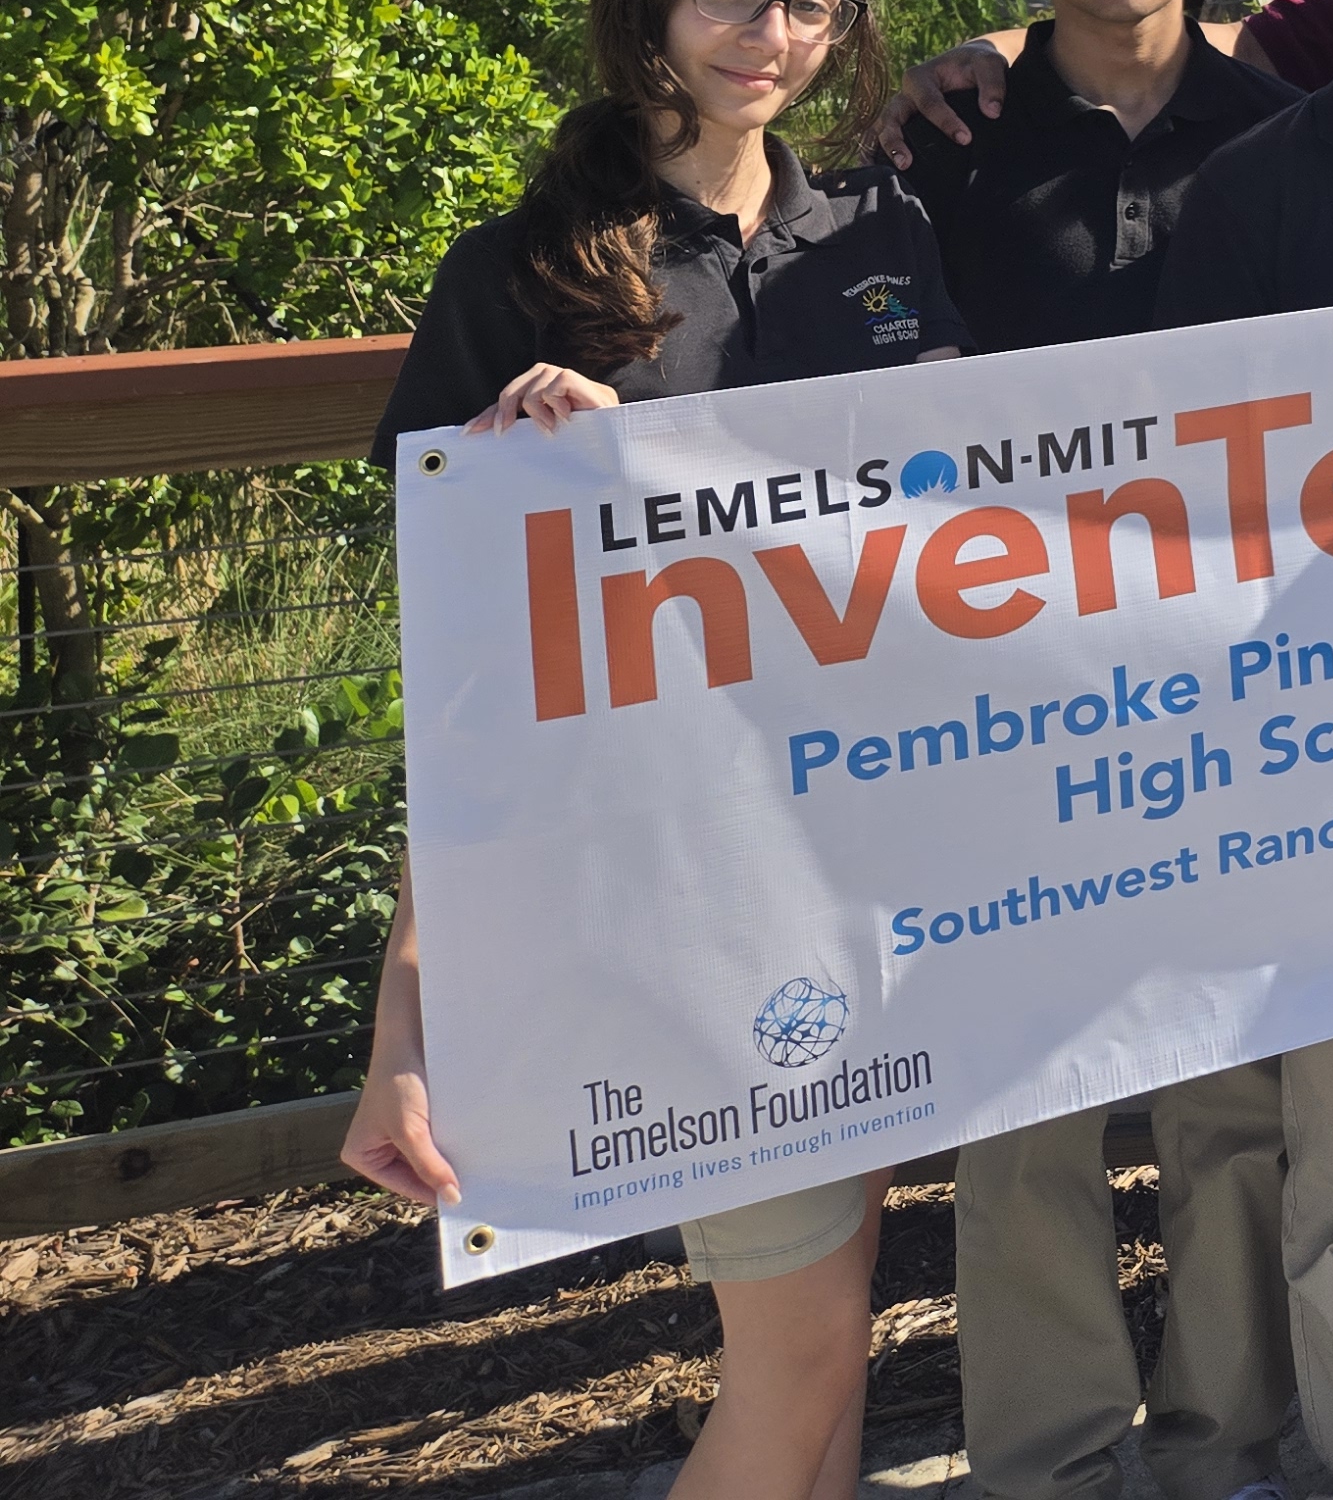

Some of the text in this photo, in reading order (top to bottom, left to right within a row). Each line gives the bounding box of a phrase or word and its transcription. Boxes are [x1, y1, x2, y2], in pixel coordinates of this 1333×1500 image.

[873, 318, 920, 334] CHARTER
[788, 665, 1201, 796] Pembroke
[1055, 731, 1232, 823] High
[892, 847, 1199, 956] Southwest
[569, 1050, 932, 1177] Lemelson Foundation
[574, 1101, 935, 1210] improving lives through invention
[583, 1079, 643, 1126] The
